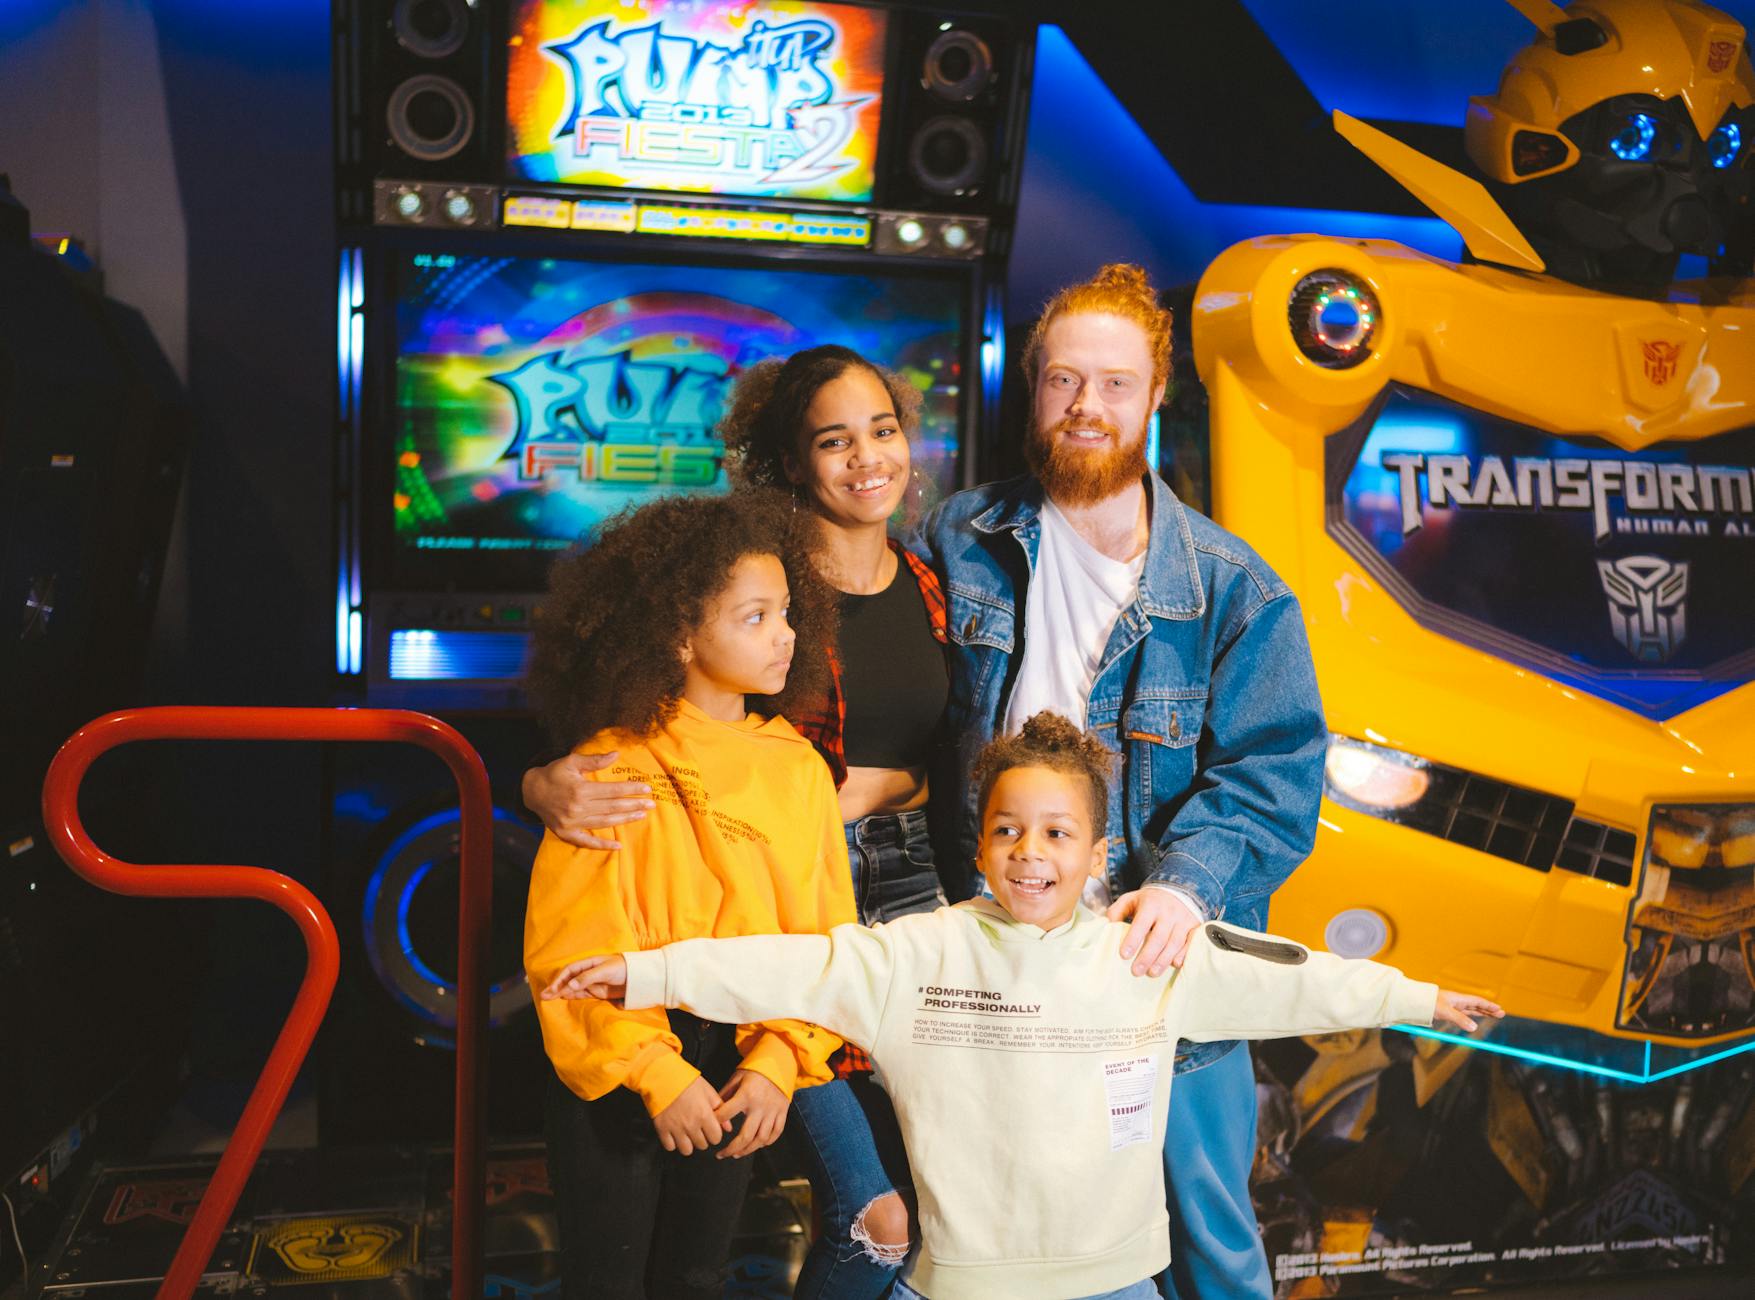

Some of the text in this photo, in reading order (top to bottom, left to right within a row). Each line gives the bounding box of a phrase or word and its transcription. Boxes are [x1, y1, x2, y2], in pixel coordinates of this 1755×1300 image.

[639, 101, 753, 127] 2013
[574, 115, 808, 170] FIESTA
[517, 441, 724, 487] FIES
[1383, 453, 1755, 545] TRANSFORM
[1616, 517, 1709, 535] HUMAN
[926, 986, 1002, 1000] COMPETING
[924, 998, 1041, 1013] PROFESSIONALLY
[940, 1021, 971, 1029] INCREASE
[929, 1035, 962, 1043] YOURSELF
[999, 1040, 1036, 1048] REMEMBER
[932, 1028, 970, 1036] TECHNIQUE
[1047, 1034, 1085, 1042] APPROPRIATE
[1105, 1062, 1125, 1070] EVENT
[1106, 1067, 1132, 1076] DECADE
[1319, 1261, 1380, 1276] Paramount
[1382, 1257, 1429, 1271] Pictures
[1501, 1249, 1515, 1260] All
[1519, 1246, 1552, 1260] Rights
[1364, 1248, 1379, 1260] All
[1382, 1246, 1417, 1261] Rights
